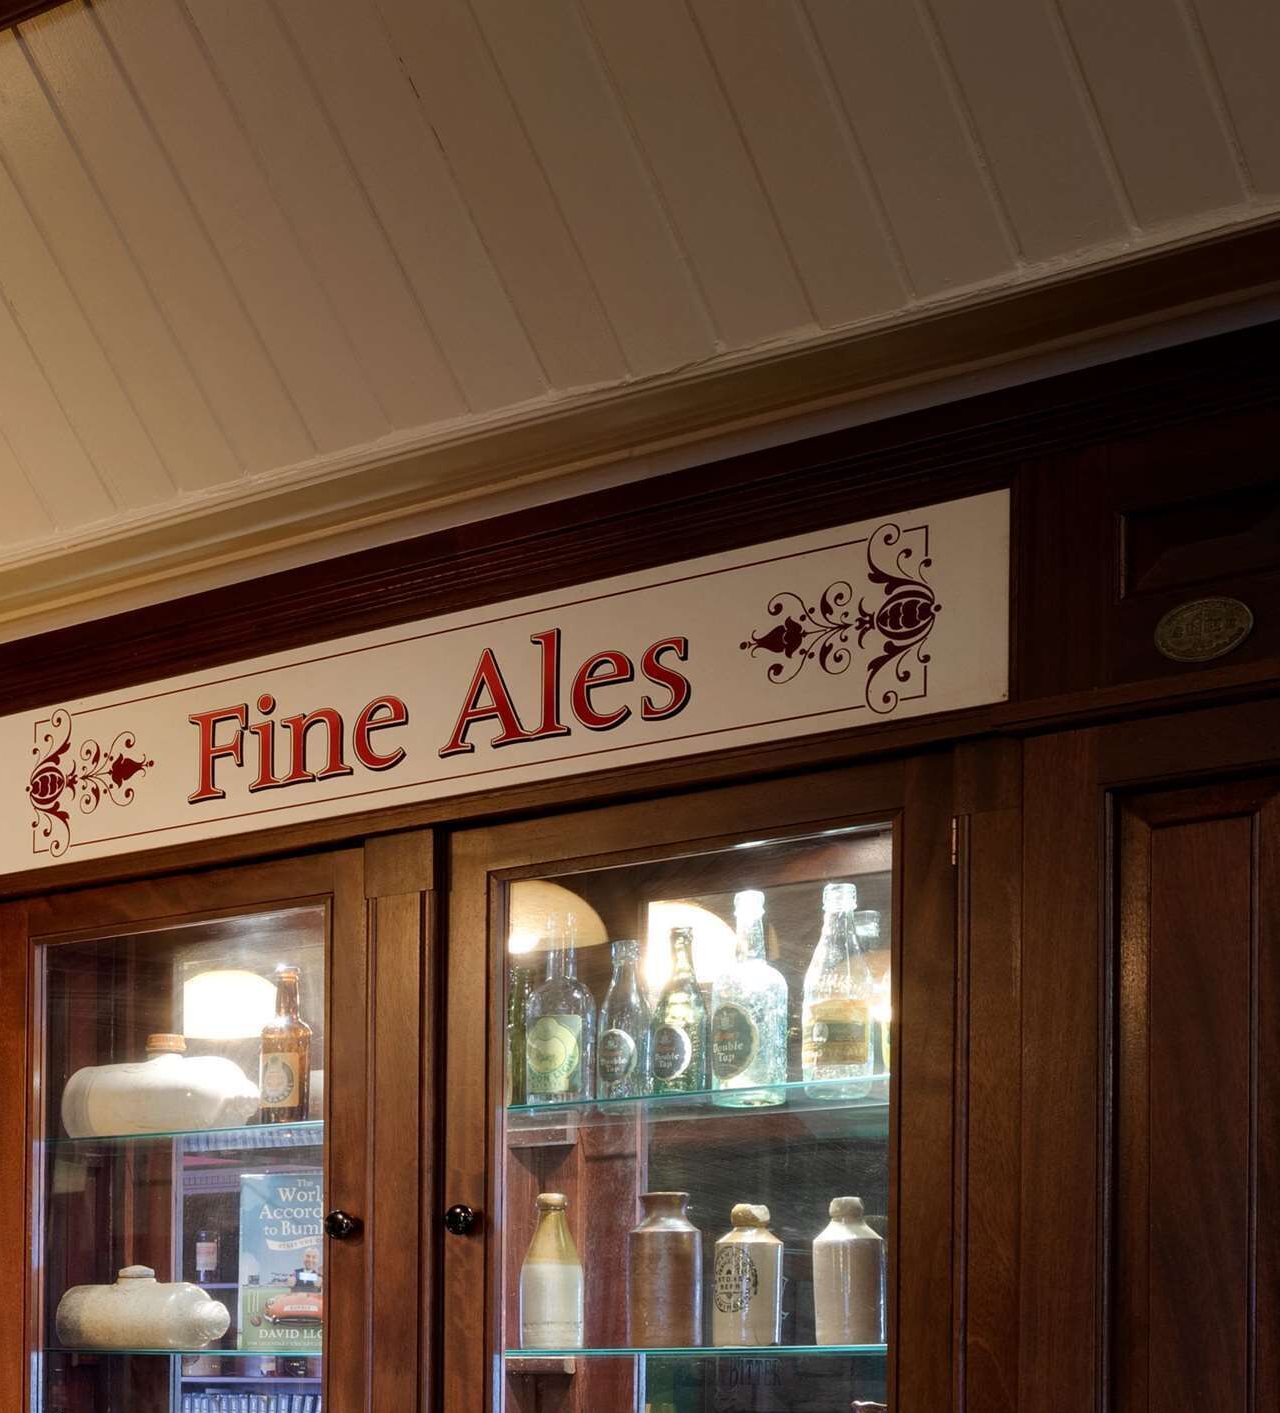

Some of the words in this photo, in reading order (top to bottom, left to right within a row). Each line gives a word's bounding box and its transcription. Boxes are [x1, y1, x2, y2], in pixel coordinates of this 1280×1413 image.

[186, 691, 409, 806] Fine
[438, 626, 692, 760] Ales
[296, 1179, 314, 1187] The
[277, 1186, 323, 1203] Worl
[259, 1204, 323, 1220] Accord
[264, 1226, 278, 1236] to
[281, 1220, 323, 1236] Bum
[258, 1329, 300, 1339] DAVID
[303, 1329, 323, 1339] LLO
